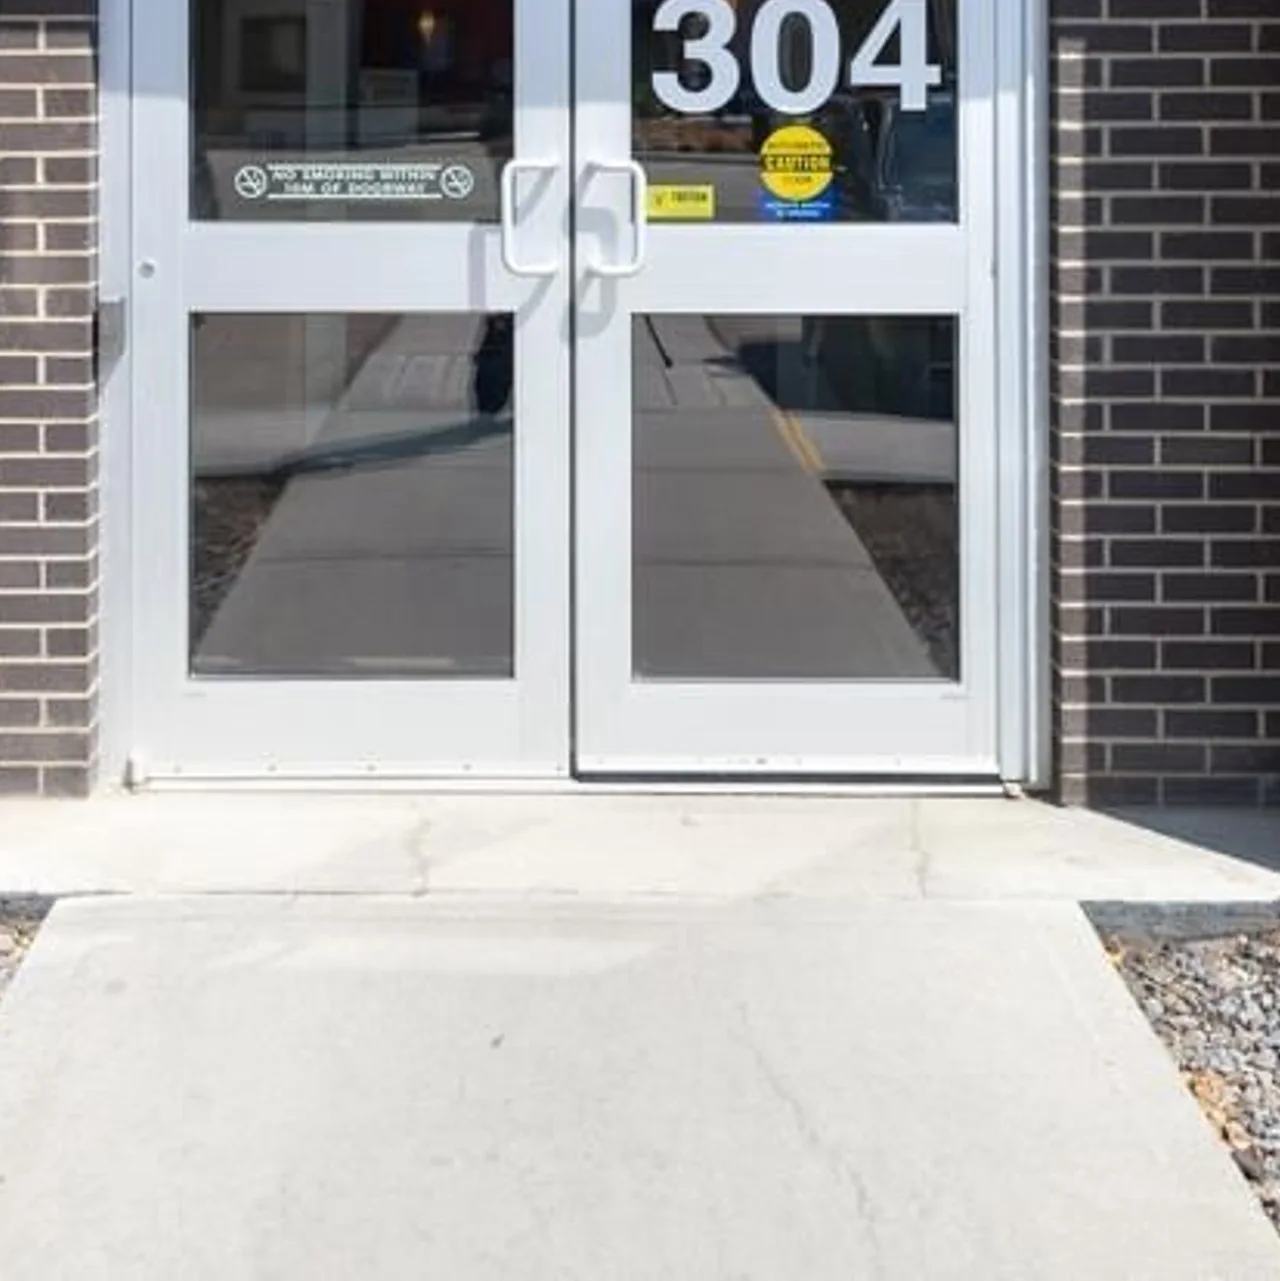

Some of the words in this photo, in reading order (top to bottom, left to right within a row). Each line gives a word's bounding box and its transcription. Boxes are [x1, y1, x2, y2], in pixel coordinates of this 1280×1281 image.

[764, 155, 830, 171] CAUTION
[271, 170, 297, 181] NO
[302, 169, 375, 181] SMOKING
[379, 169, 437, 181] WITHIN
[319, 182, 342, 195] OF
[347, 182, 427, 195] DOORWAY
